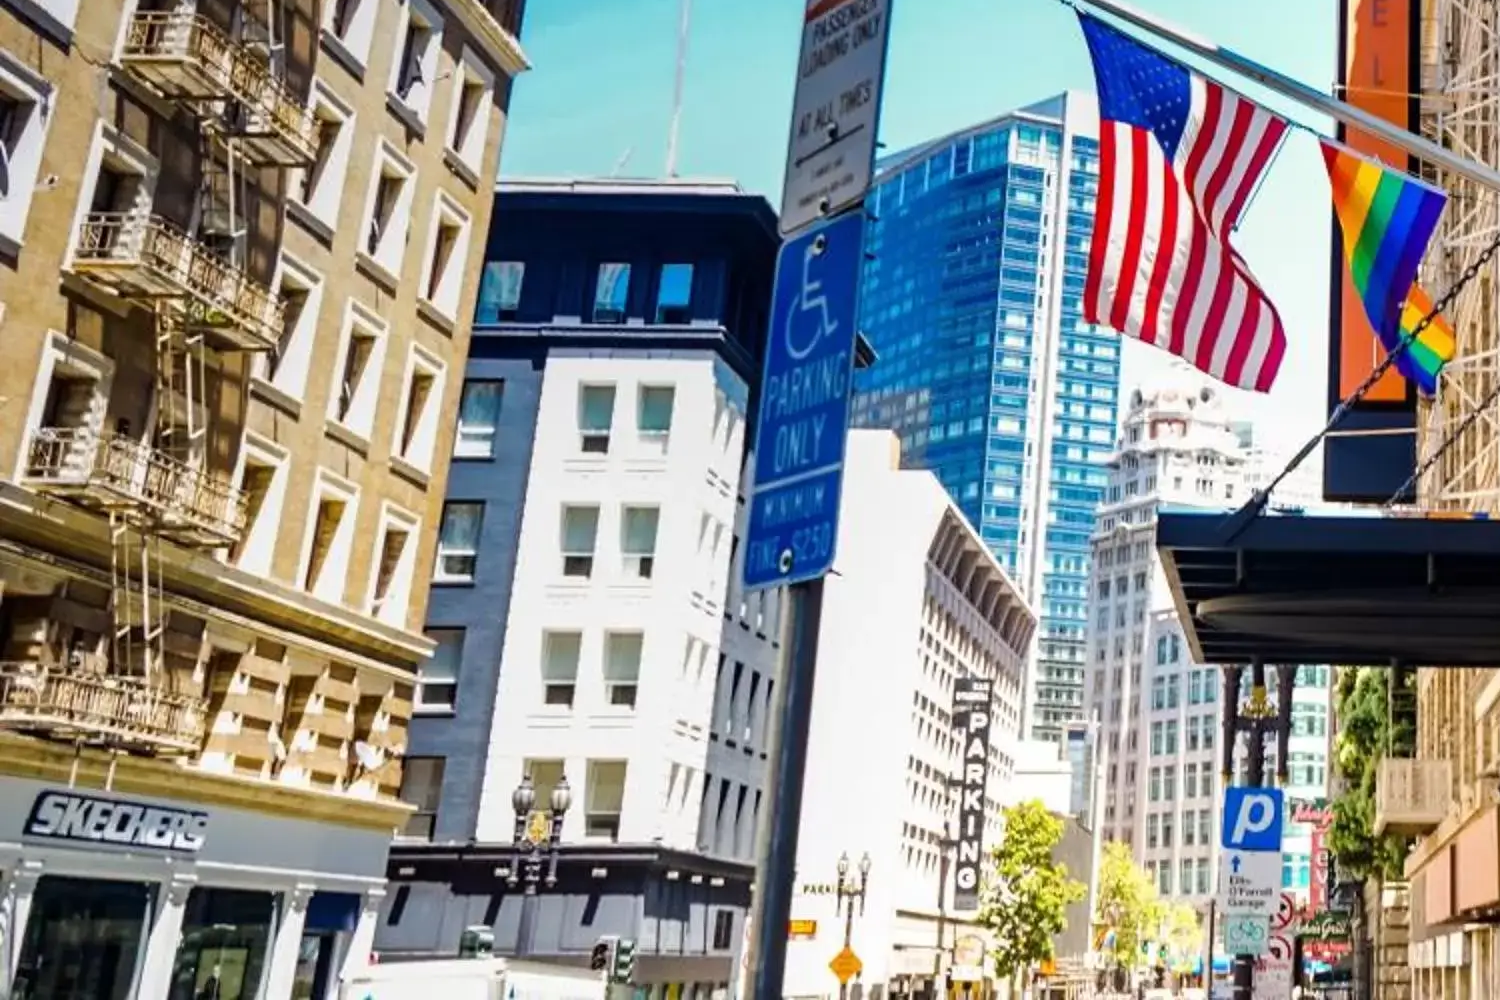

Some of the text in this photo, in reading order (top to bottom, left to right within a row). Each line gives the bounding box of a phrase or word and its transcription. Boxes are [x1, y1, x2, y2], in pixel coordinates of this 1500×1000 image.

[802, 13, 881, 78] LOADING ONLY
[814, 98, 834, 130] ALL
[839, 80, 872, 114] TIMES
[765, 349, 847, 420] PARKING
[773, 413, 828, 474] ONLY
[762, 484, 826, 528] MINIMUM
[31, 793, 209, 851] SKECHERS
[957, 713, 989, 889] PARKING
